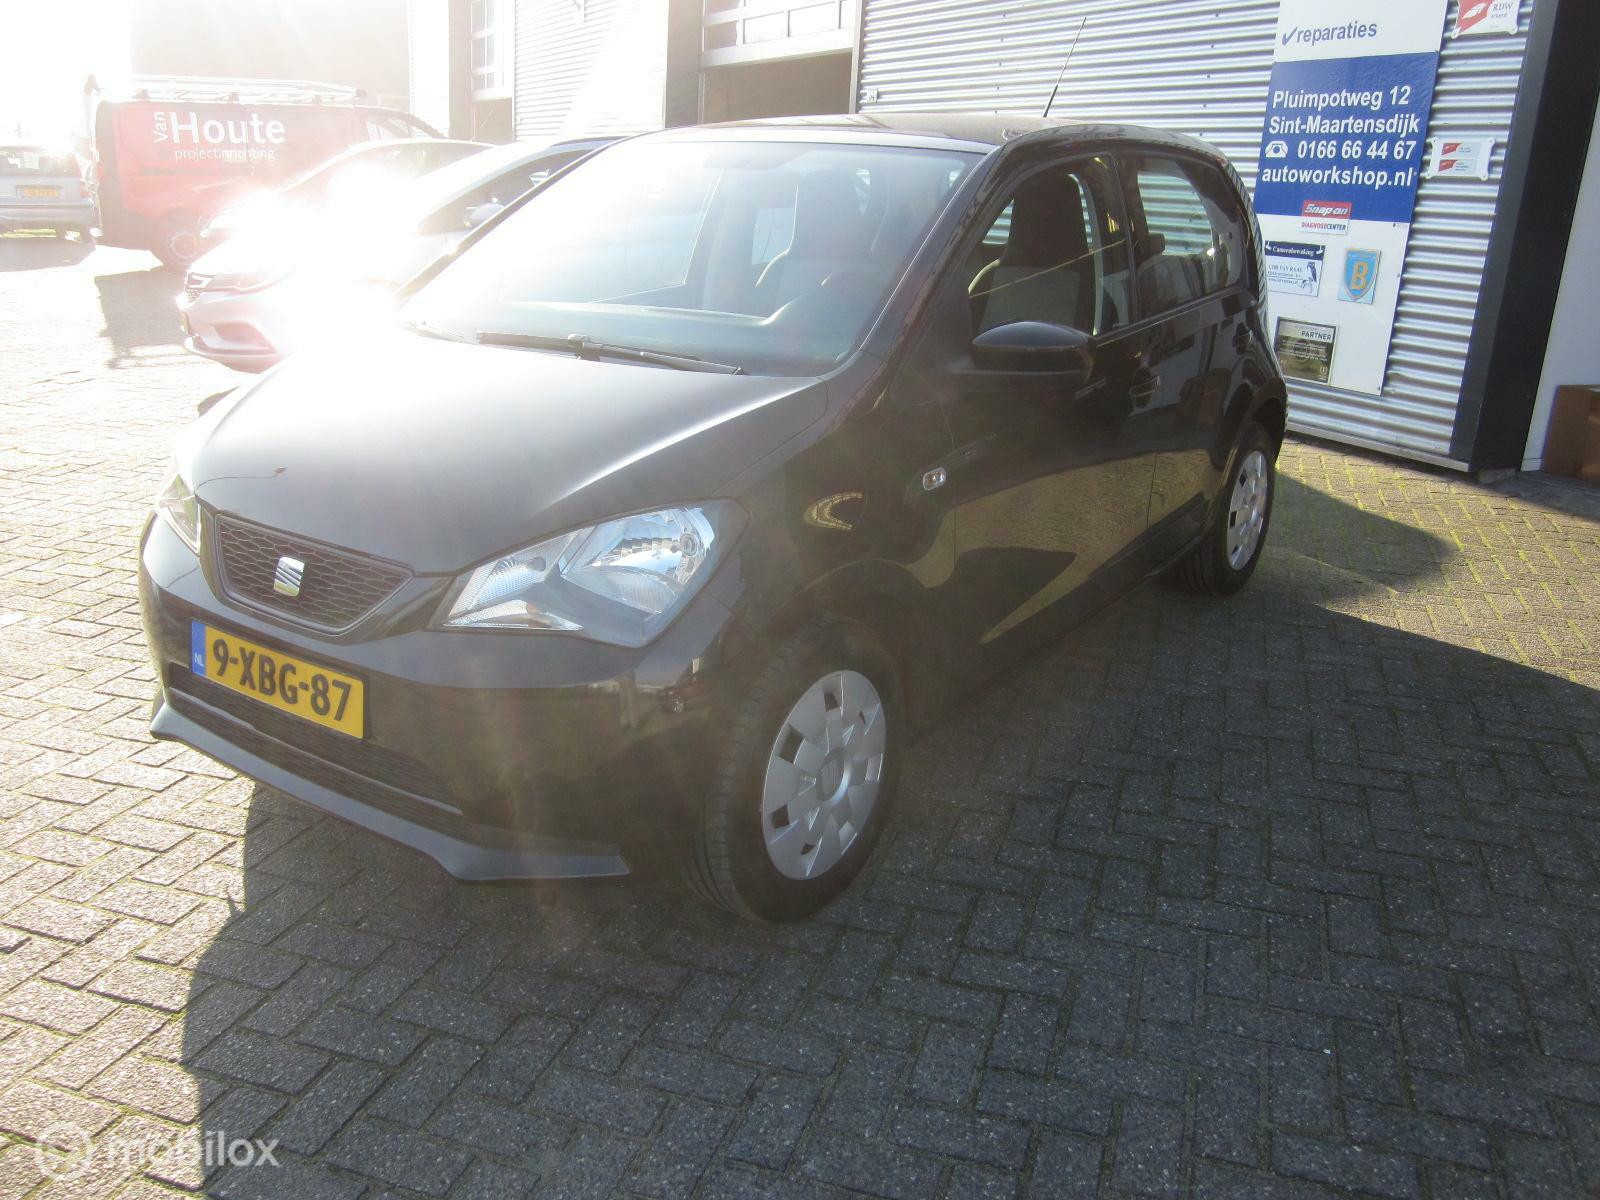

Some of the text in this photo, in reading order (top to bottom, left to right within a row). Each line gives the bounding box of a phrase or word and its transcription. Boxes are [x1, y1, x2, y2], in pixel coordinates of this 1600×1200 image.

[1297, 21, 1378, 46] reparaties
[1272, 86, 1411, 111] Pluimpotweg 12
[153, 111, 286, 144] van Houte
[1268, 114, 1420, 138] Sint-Maartensdijk
[1297, 140, 1416, 160] 0166 66 44 67
[1262, 166, 1413, 190] autoworkshop.nl
[1304, 203, 1349, 216] Snap-on
[1301, 330, 1332, 341] PARTNER
[194, 652, 204, 668] NL
[212, 638, 352, 722] 9-XBG-87
